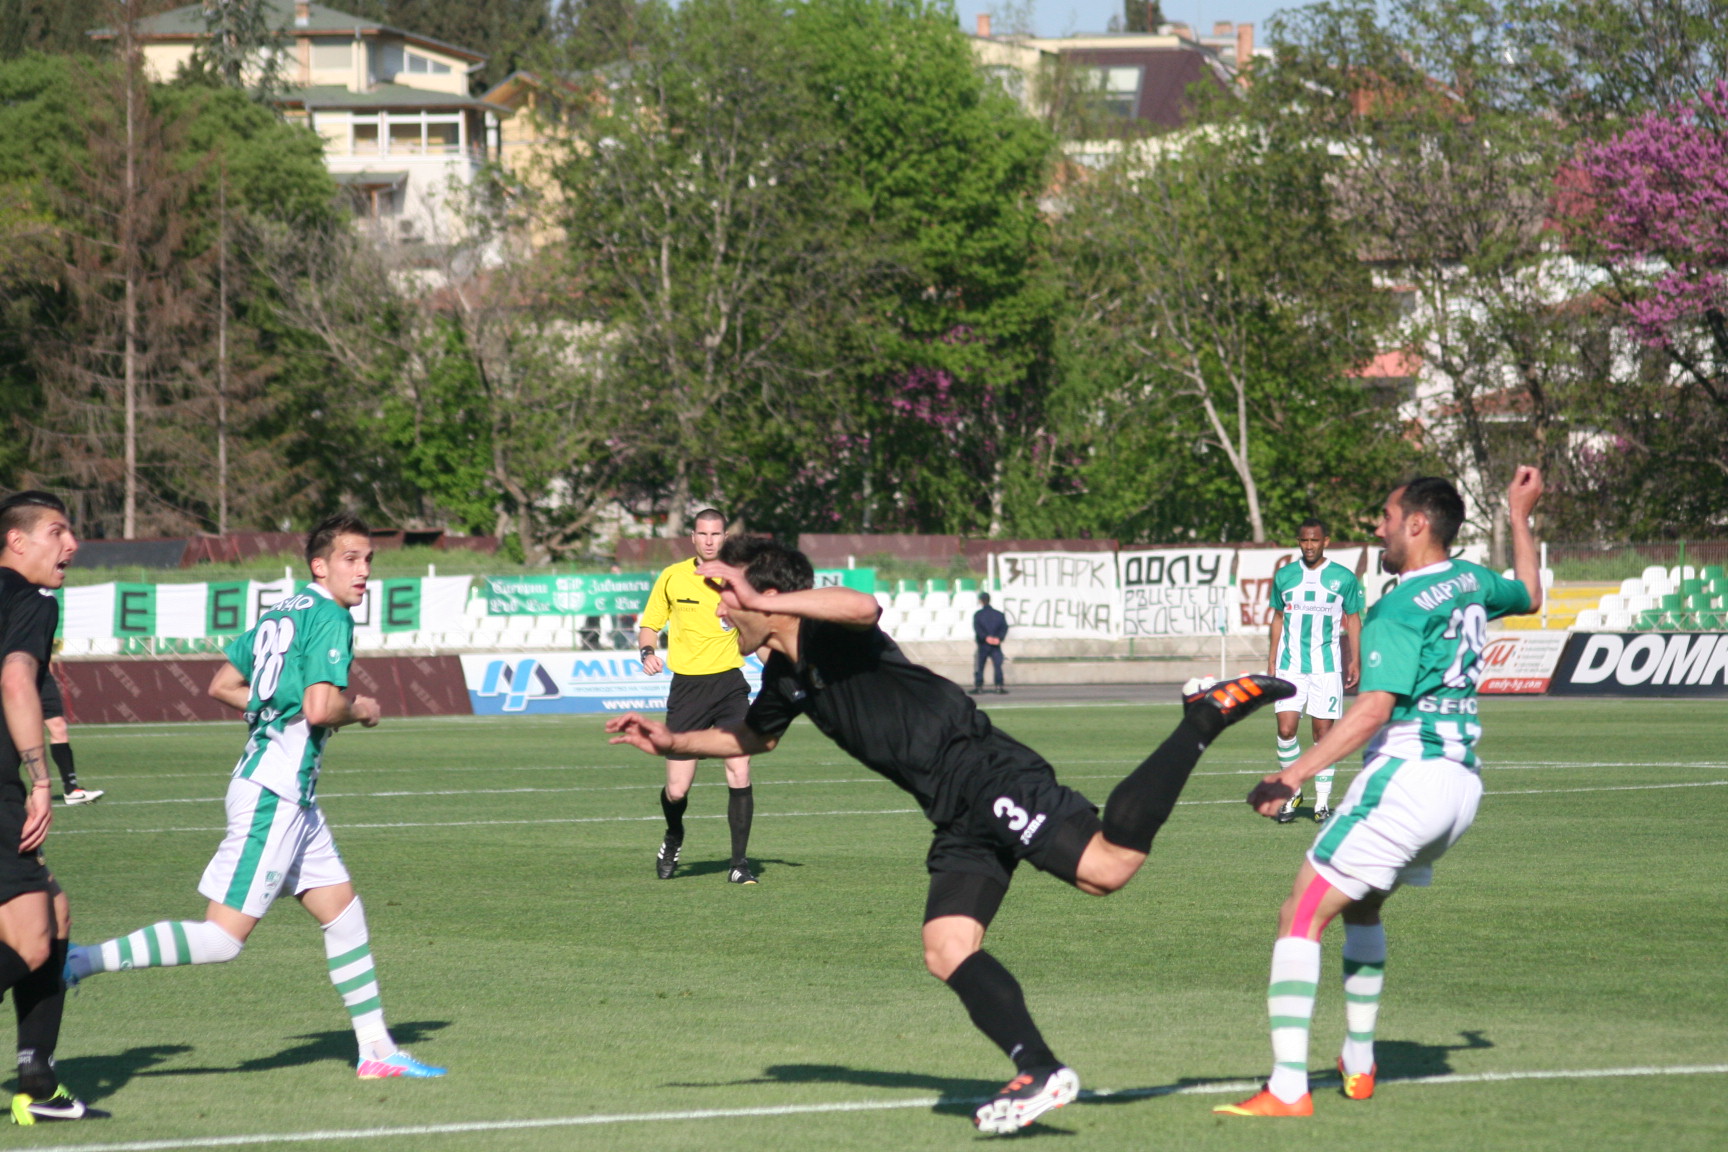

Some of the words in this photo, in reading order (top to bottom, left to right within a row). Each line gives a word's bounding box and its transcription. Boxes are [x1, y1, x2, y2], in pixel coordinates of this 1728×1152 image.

[1125, 554, 1221, 587] ДОЛУ
[1003, 598, 1112, 634] БЕДЕЧКА
[1124, 606, 1230, 635] БЕДЕЧКА
[1328, 696, 1338, 713] 2
[993, 796, 1029, 831] 3
